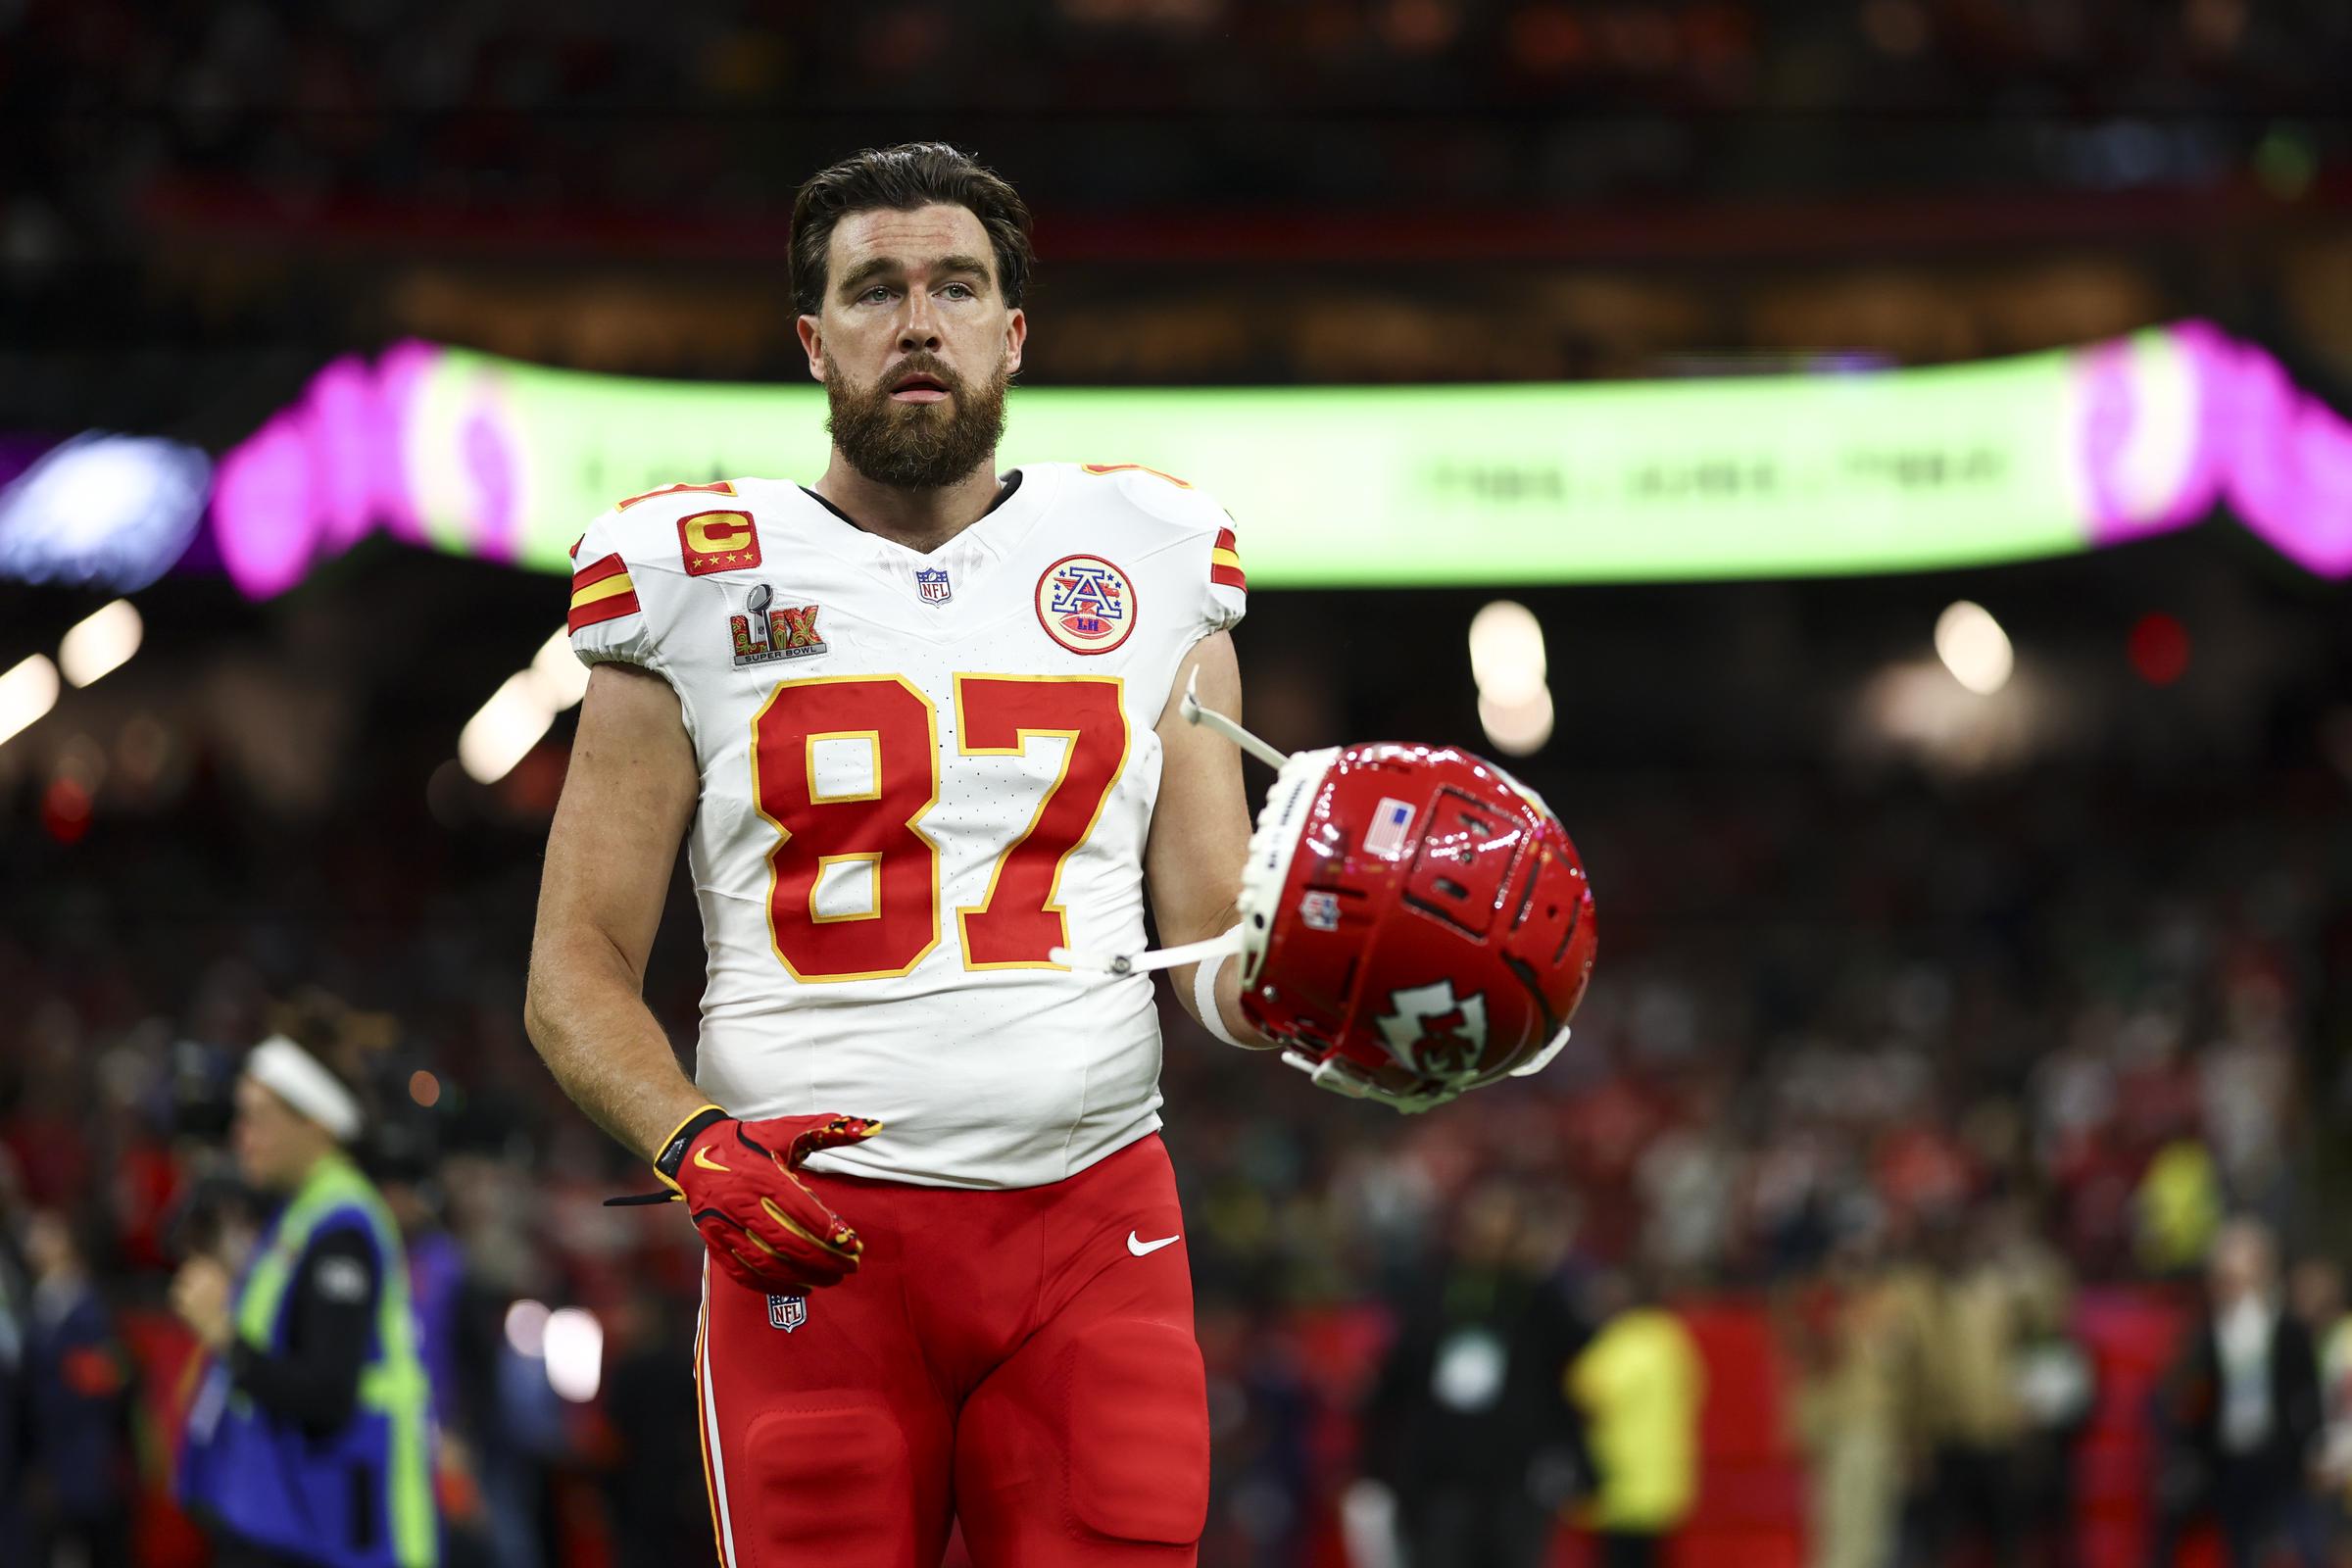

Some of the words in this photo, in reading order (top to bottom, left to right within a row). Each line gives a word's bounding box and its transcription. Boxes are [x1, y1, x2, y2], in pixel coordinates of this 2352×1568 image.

[684, 513, 752, 554] C
[921, 583, 948, 599] NFL
[1077, 617, 1099, 631] LH
[744, 649, 782, 662] SUPER
[785, 645, 817, 658] BOWL
[750, 671, 1131, 984] 87
[774, 1303, 801, 1324] NFL
